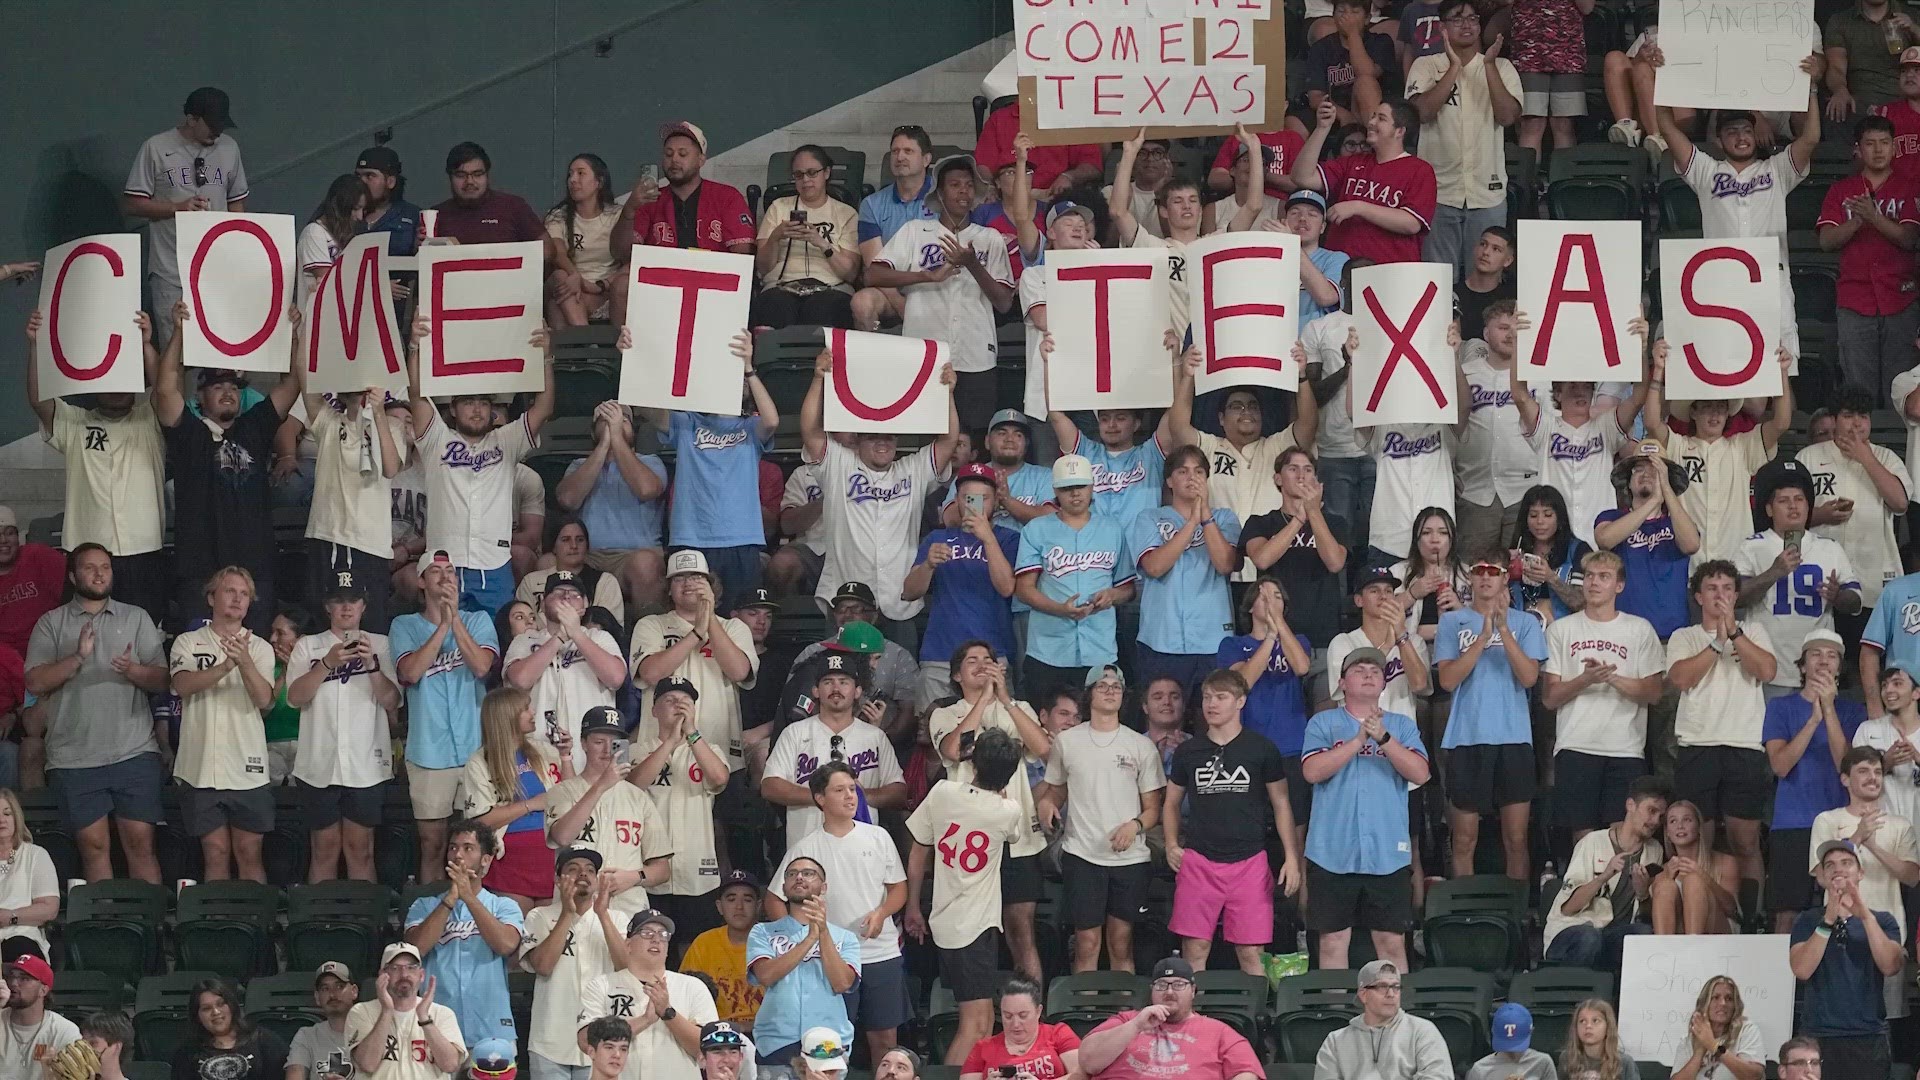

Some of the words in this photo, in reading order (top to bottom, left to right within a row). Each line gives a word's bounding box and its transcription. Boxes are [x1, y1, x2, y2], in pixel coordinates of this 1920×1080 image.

[1025, 20, 1186, 63] COME
[1212, 18, 1249, 59] 2
[1044, 74, 1256, 117] TEXAS
[1345, 177, 1403, 209] TEXAS
[1711, 172, 1773, 200] Rangers
[49, 219, 526, 381] COME
[1057, 234, 1765, 412] TEXAS
[694, 427, 748, 451] Rangers
[440, 440, 504, 472] Rangers
[1044, 545, 1117, 578] Rangers
[756, 589, 768, 601] T
[846, 582, 858, 593] T
[1773, 564, 1823, 618] 19
[1570, 639, 1628, 660] Rangers
[615, 820, 642, 847] 53
[937, 822, 990, 873] 48
[1503, 1023, 1517, 1038] T
